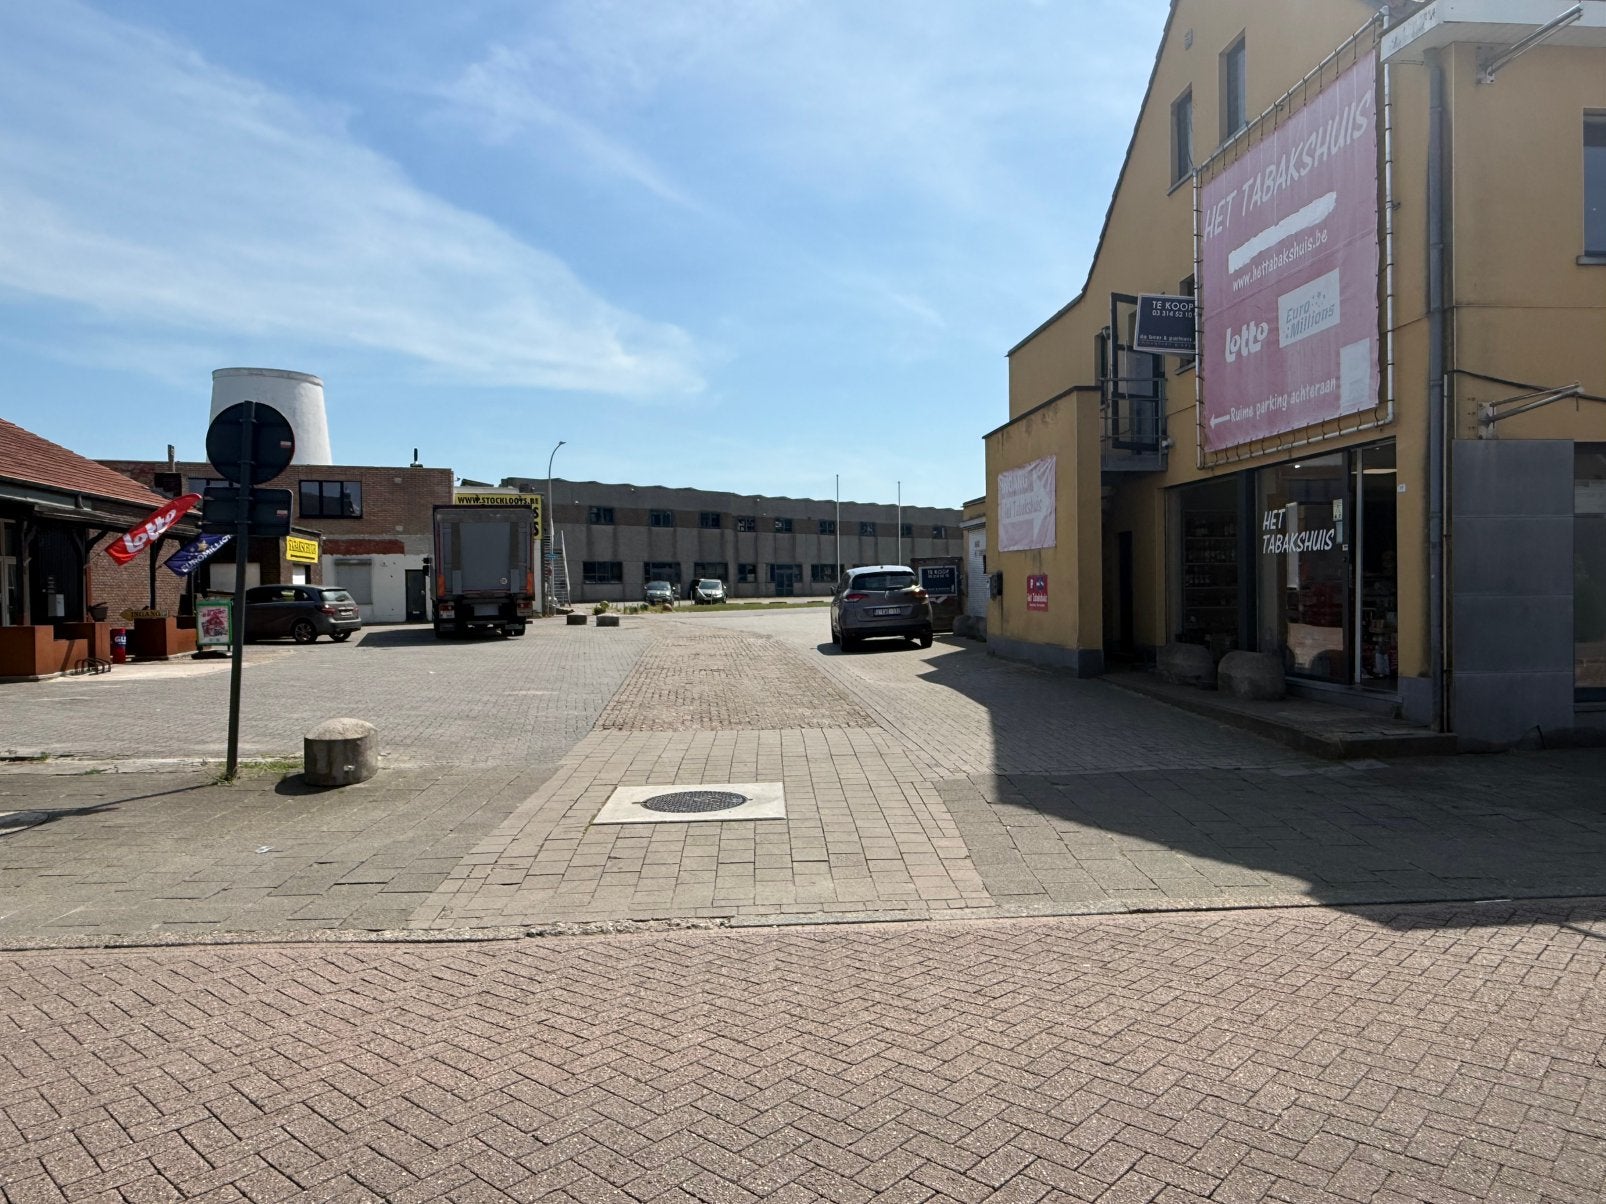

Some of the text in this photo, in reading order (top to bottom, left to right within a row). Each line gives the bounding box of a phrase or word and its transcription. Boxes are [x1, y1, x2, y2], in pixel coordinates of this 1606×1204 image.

[1204, 90, 1372, 242] HET TABAKSHUIS
[1232, 228, 1328, 292] www.hettabakshuis.be
[1152, 300, 1194, 311] TE KOOP
[1285, 301, 1310, 323] Euro
[1288, 303, 1335, 339] Millions
[1230, 377, 1336, 422] Ruime parking achteraan
[123, 509, 177, 554] Lotto
[1262, 508, 1287, 531] HET
[1262, 528, 1335, 554] TABAKSHUIS
